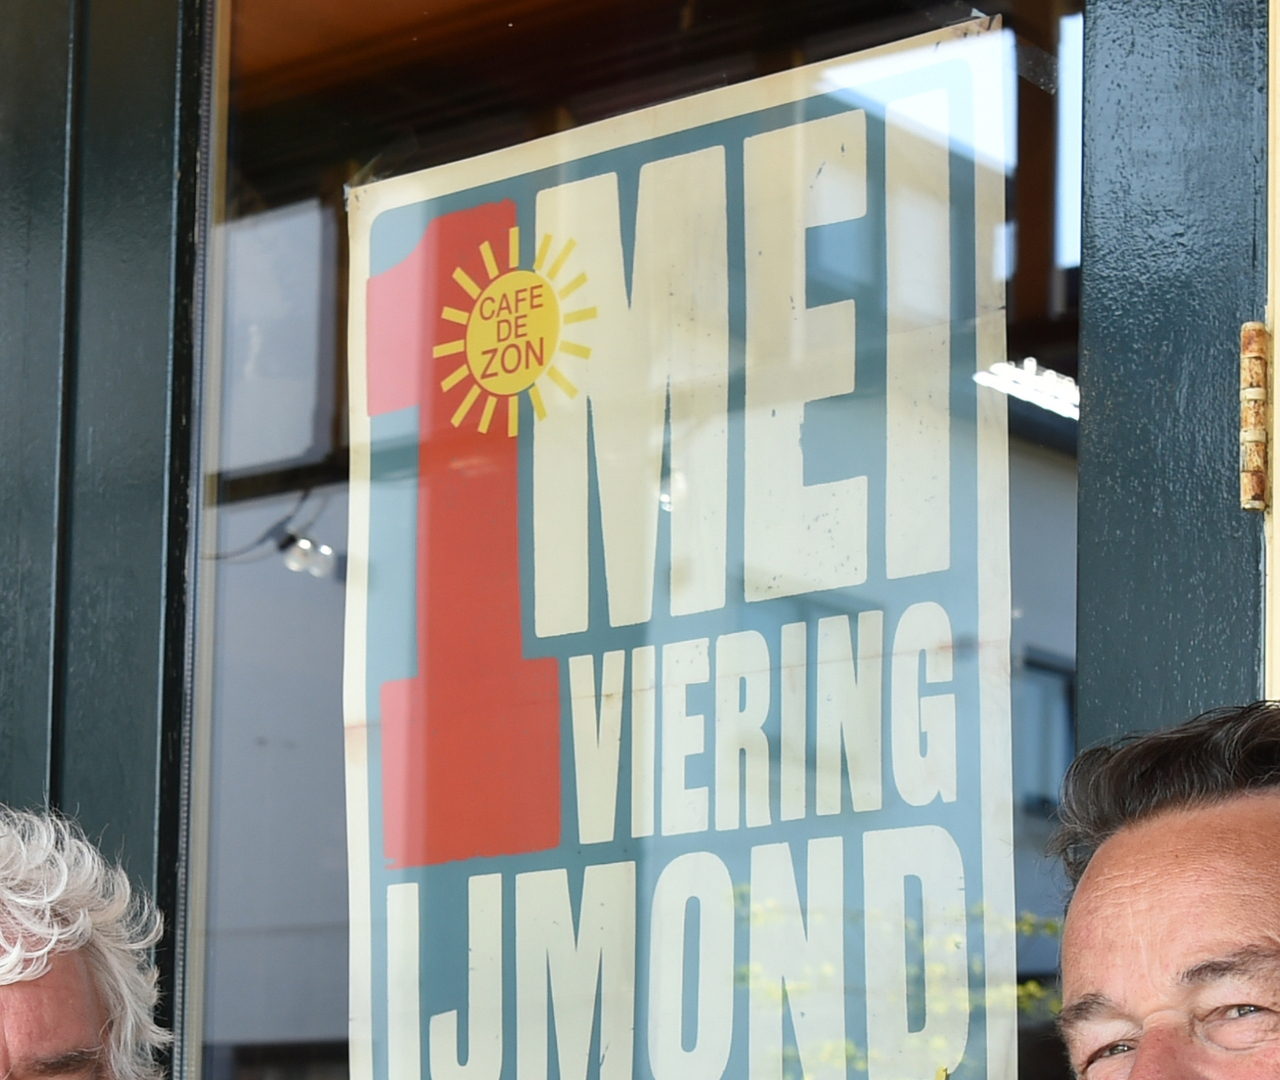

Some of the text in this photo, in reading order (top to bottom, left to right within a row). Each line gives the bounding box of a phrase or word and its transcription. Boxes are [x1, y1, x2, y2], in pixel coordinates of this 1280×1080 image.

[478, 284, 544, 321] CAFE
[496, 314, 528, 343] DE
[480, 337, 544, 380] ZON
[366, 88, 950, 869] 1 MEI
[568, 601, 957, 845] VIERING
